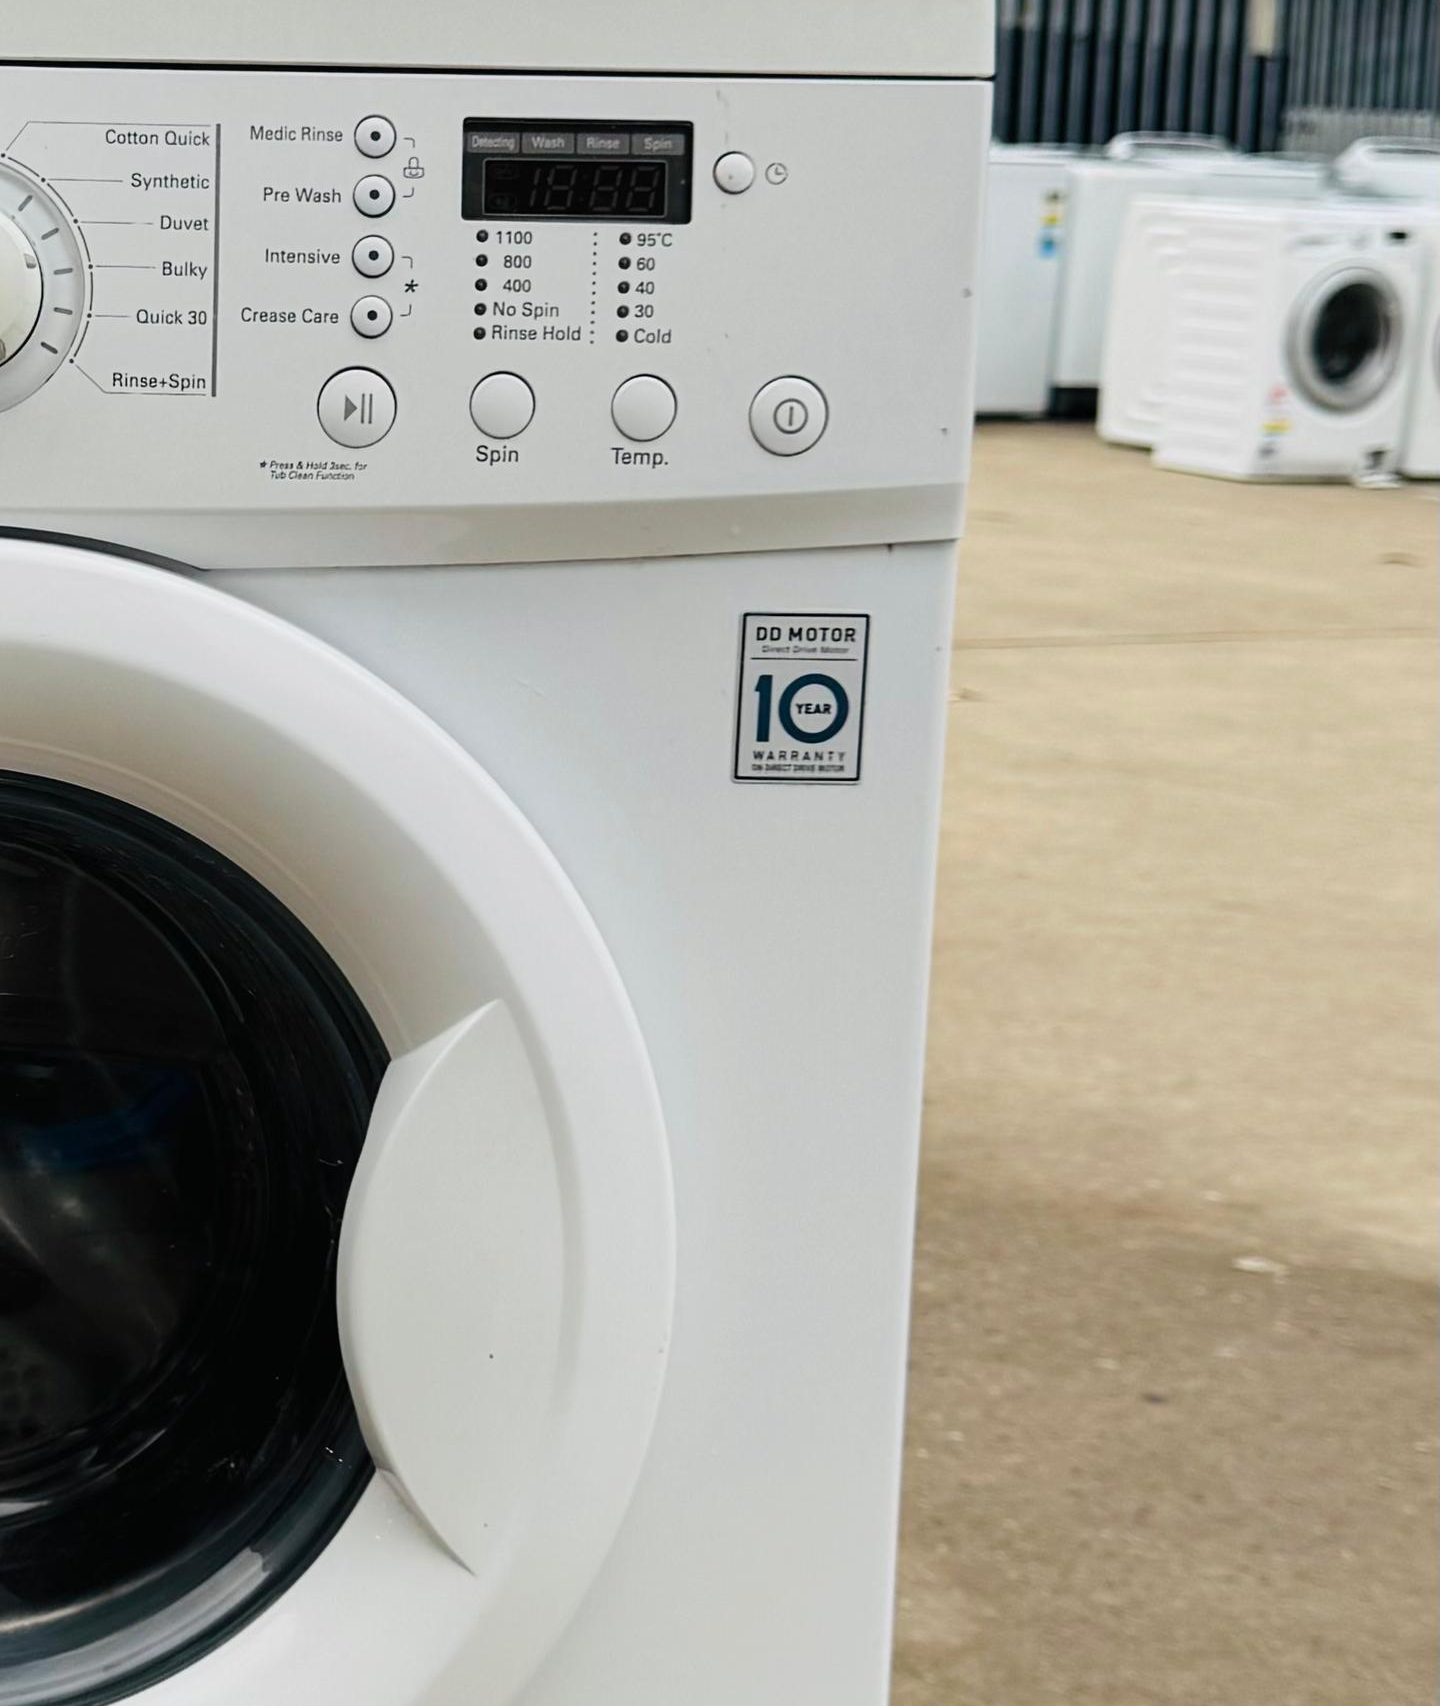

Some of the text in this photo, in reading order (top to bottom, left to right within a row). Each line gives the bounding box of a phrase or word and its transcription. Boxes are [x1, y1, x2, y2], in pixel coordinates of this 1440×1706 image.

[105, 129, 210, 148] Cotton Quick
[250, 125, 344, 142] Medic Rinse
[471, 135, 515, 151] Detecting
[532, 136, 565, 148] Wash
[586, 137, 619, 149] Rinse
[644, 138, 673, 151] Spin
[131, 173, 210, 192] Synthetic
[264, 188, 342, 203] Pre Wash
[160, 215, 209, 232] Duvet
[496, 231, 533, 245] 1100
[265, 249, 340, 265] Intensive
[503, 255, 532, 269] 800
[637, 257, 656, 272] 60
[162, 261, 208, 280] Bulky
[503, 279, 532, 293] 400
[636, 281, 655, 295] 40
[136, 309, 208, 326] Quick 30
[241, 307, 339, 325] Crease Care
[493, 302, 560, 321] No Spin
[634, 305, 654, 320] 30
[492, 326, 582, 342] Rinse Hold
[635, 329, 672, 344] Cold
[112, 372, 207, 392] Rinse+Spin
[475, 446, 520, 467] Spin
[611, 447, 669, 468] Temp.
[756, 626, 857, 643] DD MOTOR
[795, 703, 832, 715] YEAR
[752, 750, 846, 762] WARRANTY
